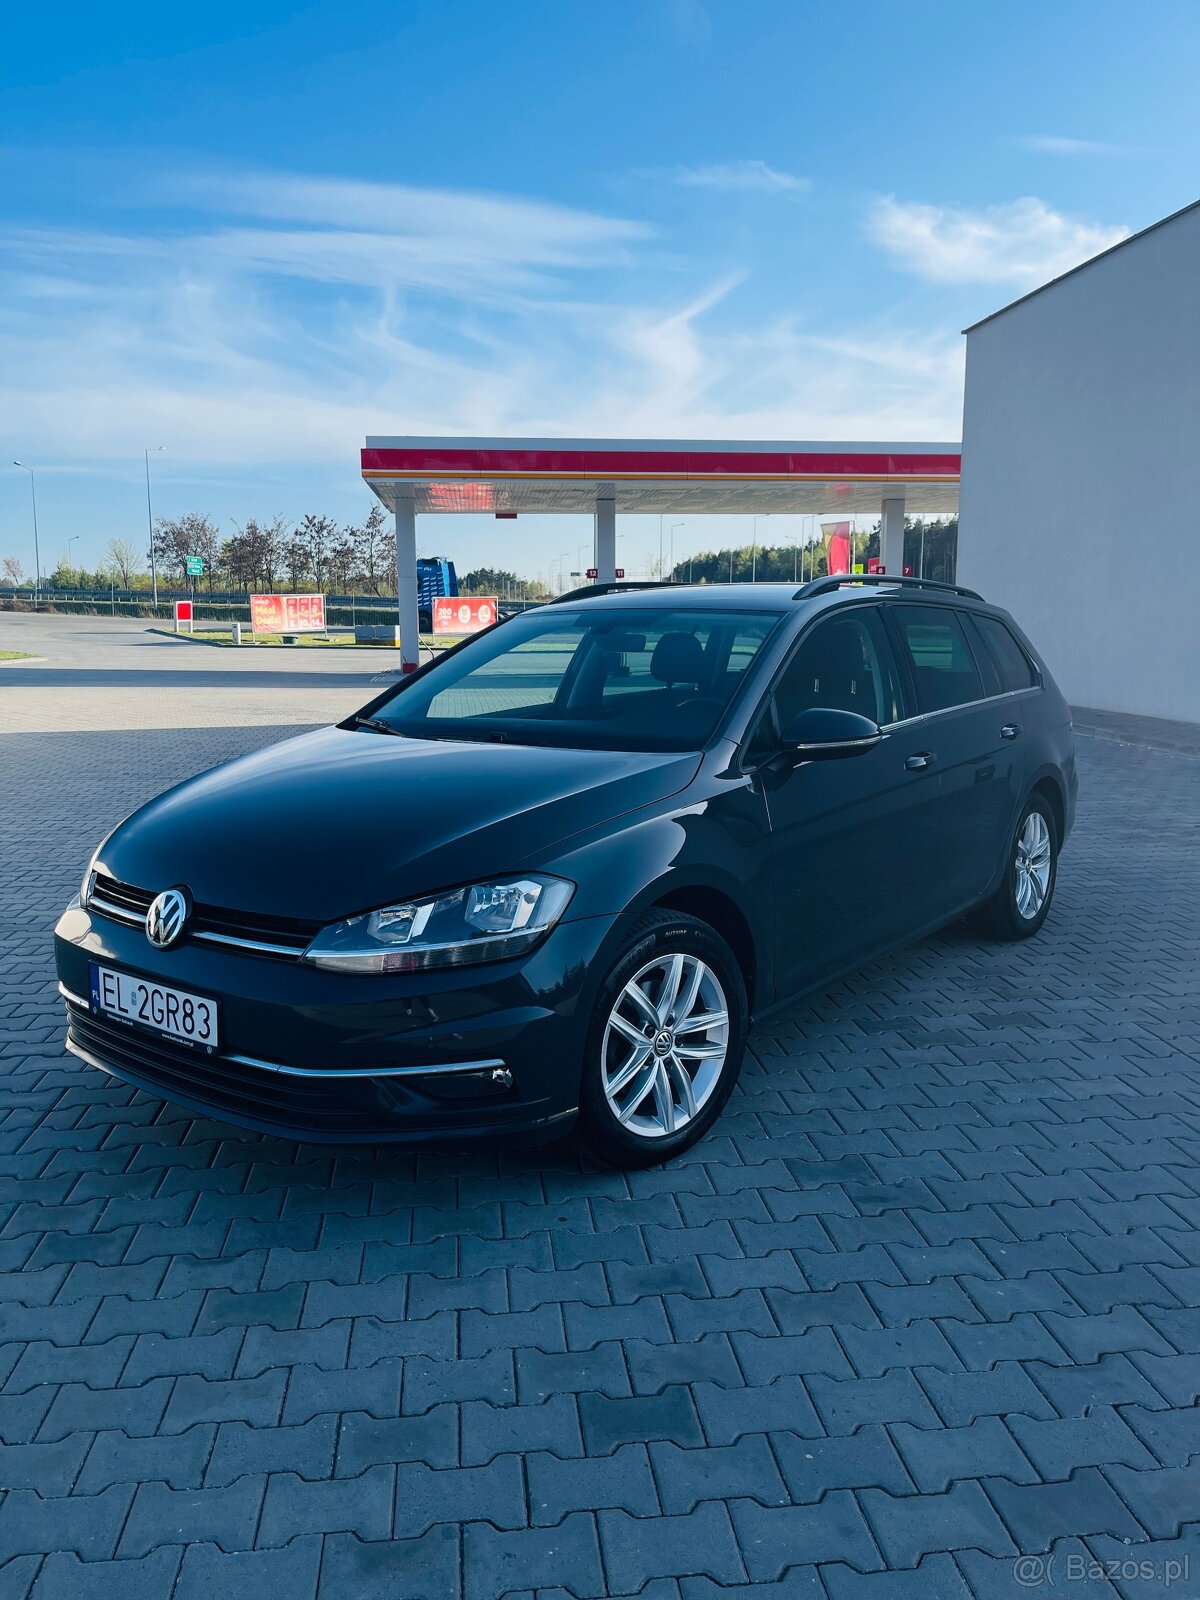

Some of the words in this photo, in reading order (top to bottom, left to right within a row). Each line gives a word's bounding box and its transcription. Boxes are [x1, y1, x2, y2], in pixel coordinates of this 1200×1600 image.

[255, 605, 276, 615] Meal
[437, 607, 453, 617] 200
[255, 615, 281, 626] Deals!
[91, 989, 100, 1001] PL
[102, 972, 129, 1014] EL
[137, 984, 211, 1040] 2GR83
